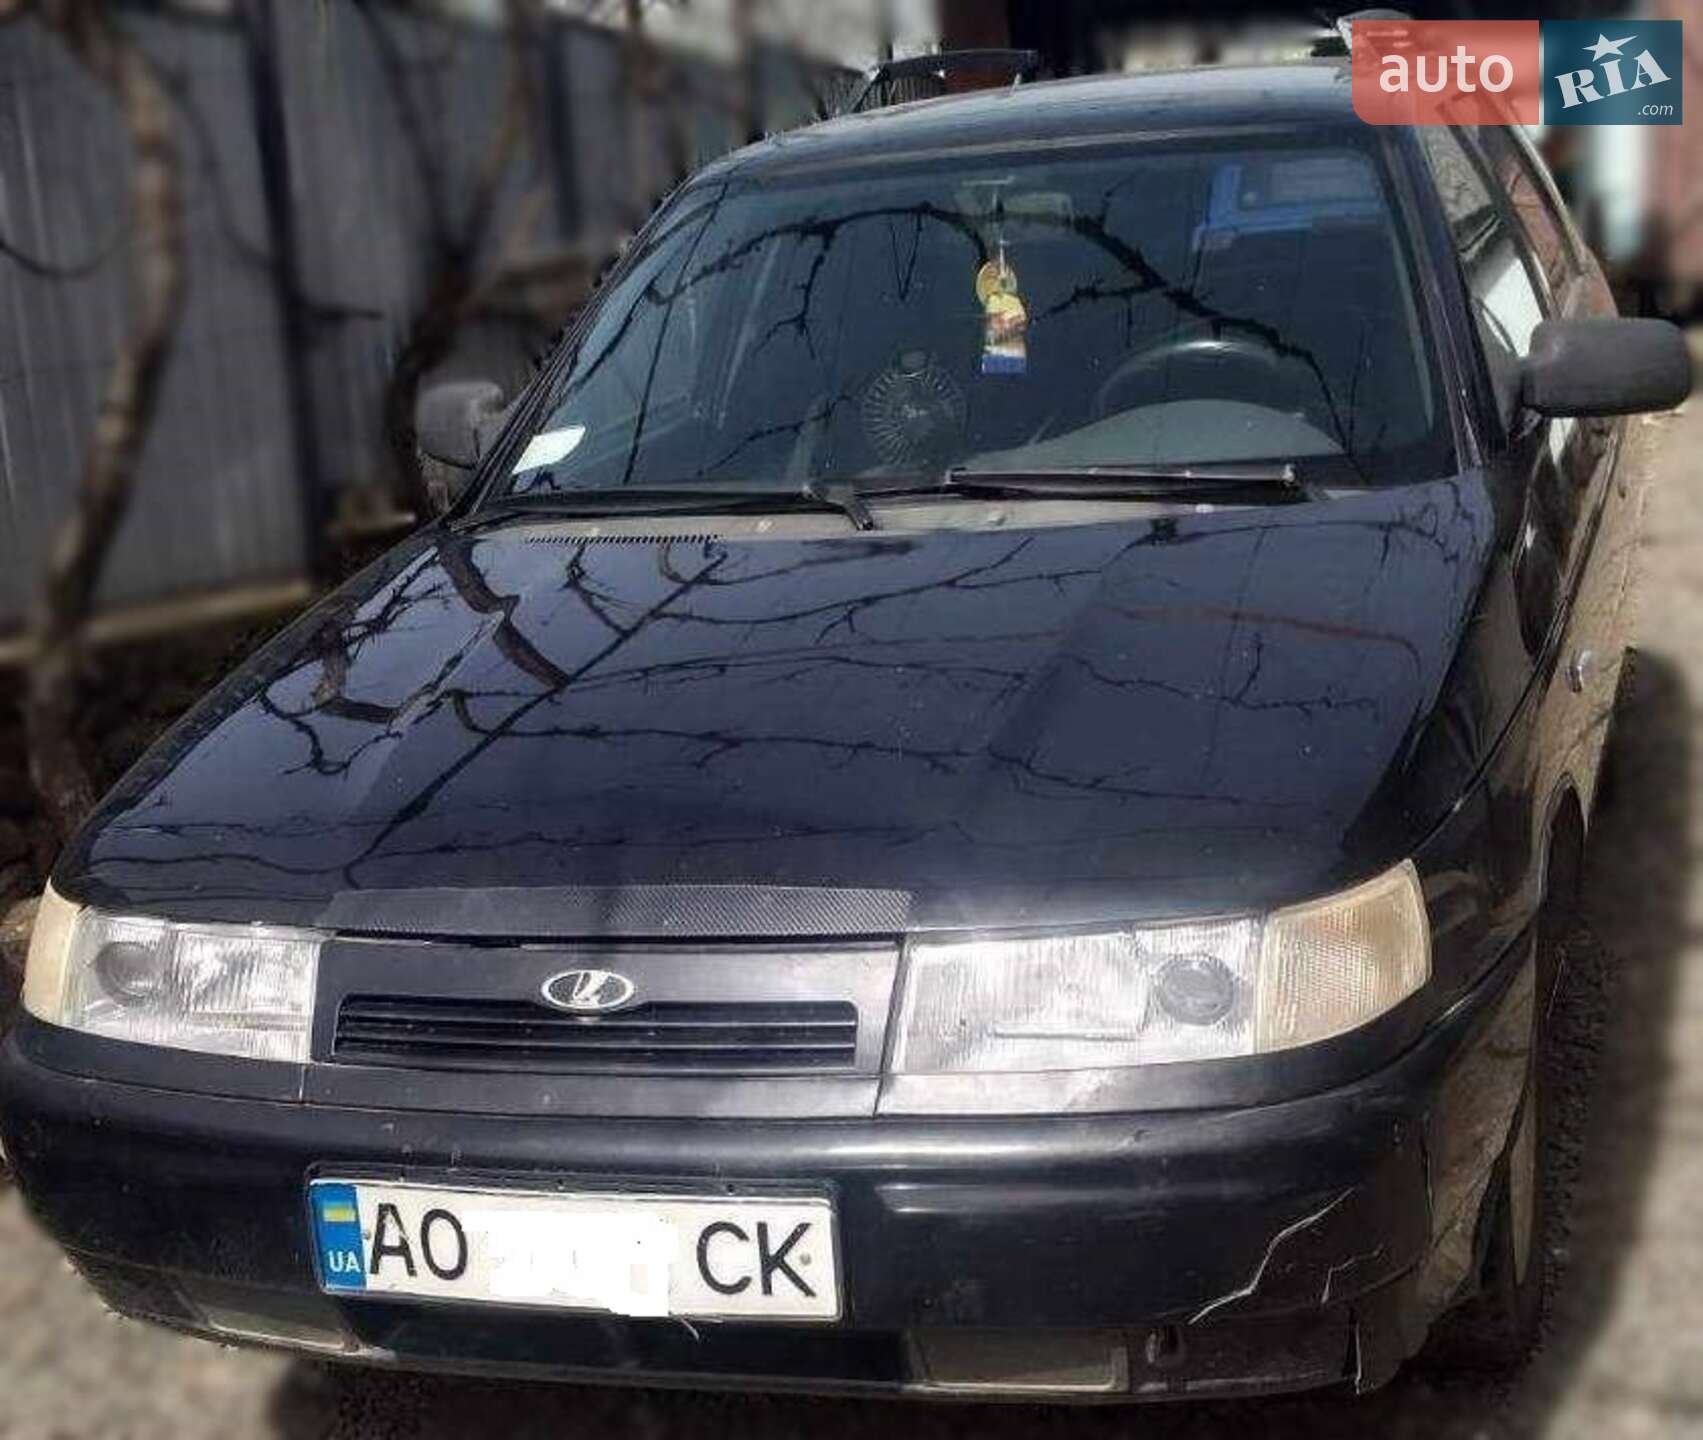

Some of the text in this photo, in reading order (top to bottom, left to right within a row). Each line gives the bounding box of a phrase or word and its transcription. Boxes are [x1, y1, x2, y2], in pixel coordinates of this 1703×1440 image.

[328, 1250, 362, 1274] UA
[368, 1202, 817, 1297] AO CK
